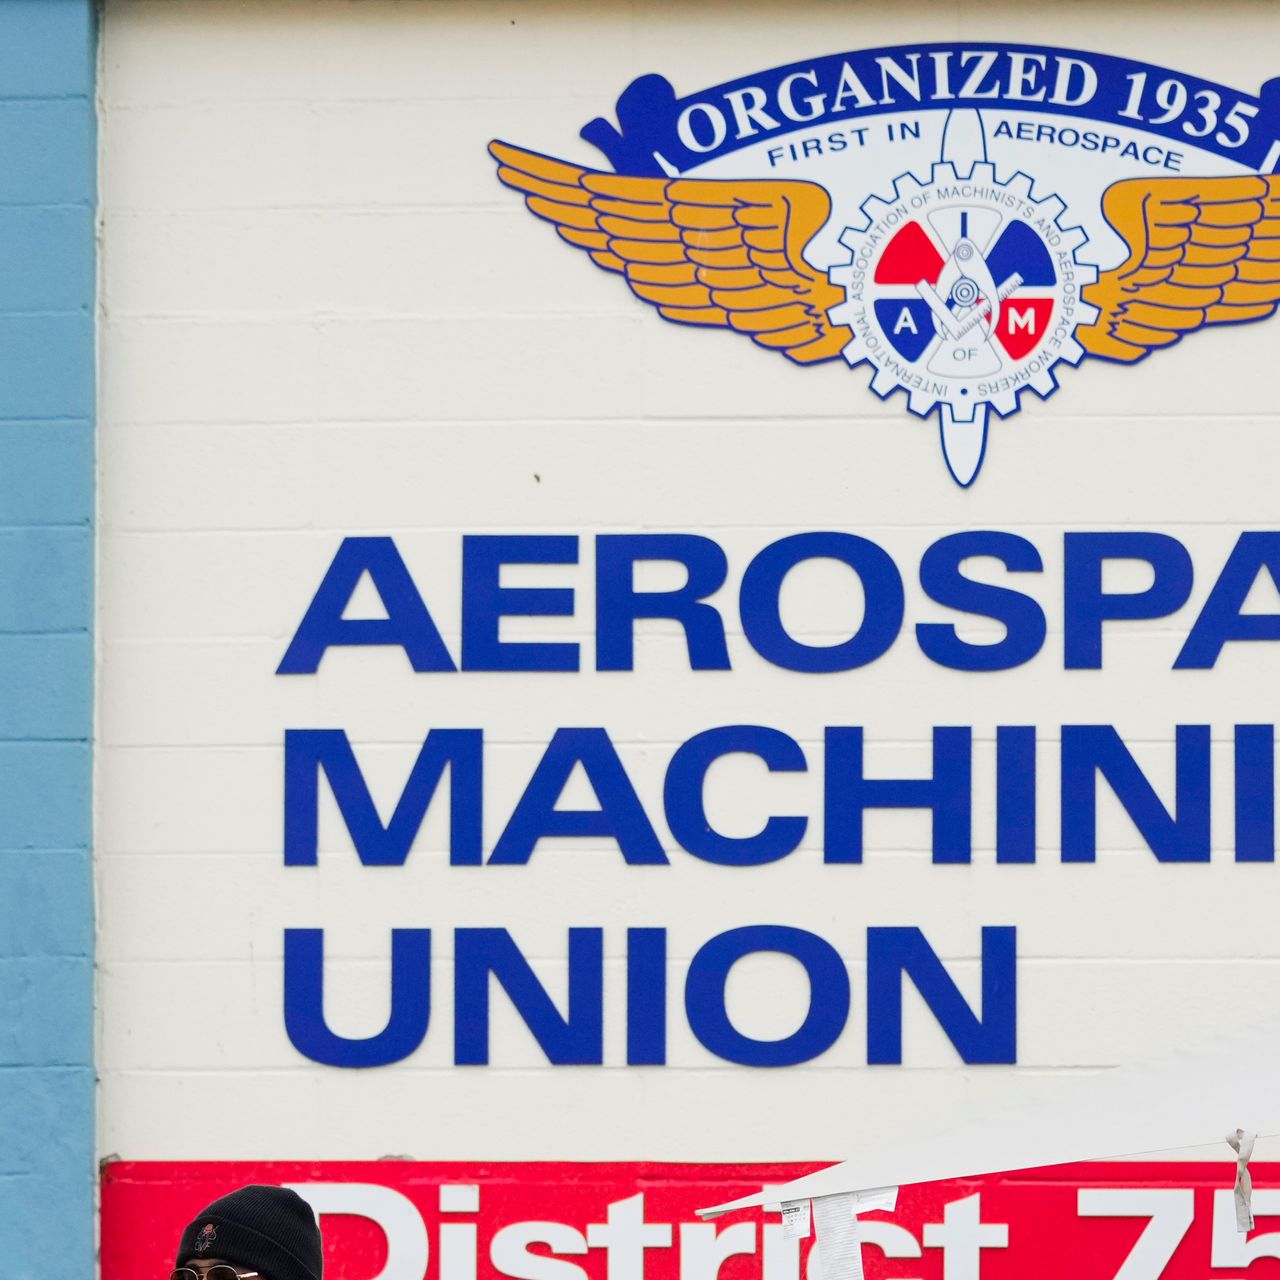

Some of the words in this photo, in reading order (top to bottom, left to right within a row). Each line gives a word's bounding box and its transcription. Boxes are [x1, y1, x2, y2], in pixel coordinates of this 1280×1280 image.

[676, 51, 1098, 156] ORGANIZED
[1118, 71, 1261, 152] 1935
[766, 127, 869, 168] FIRST
[882, 119, 922, 146] IN
[993, 120, 1185, 174] AEROSPACE
[910, 191, 932, 209] OF
[936, 185, 1035, 218] MACHINISTS
[850, 204, 909, 302] ASSOCIATION
[1035, 218, 1062, 247] AND
[1047, 250, 1076, 348] AEROSPACE
[853, 305, 948, 397] INTERNATIONAL
[952, 349, 978, 361] OF
[977, 349, 1053, 397] WORKERS
[283, 925, 1017, 1069] UNION
